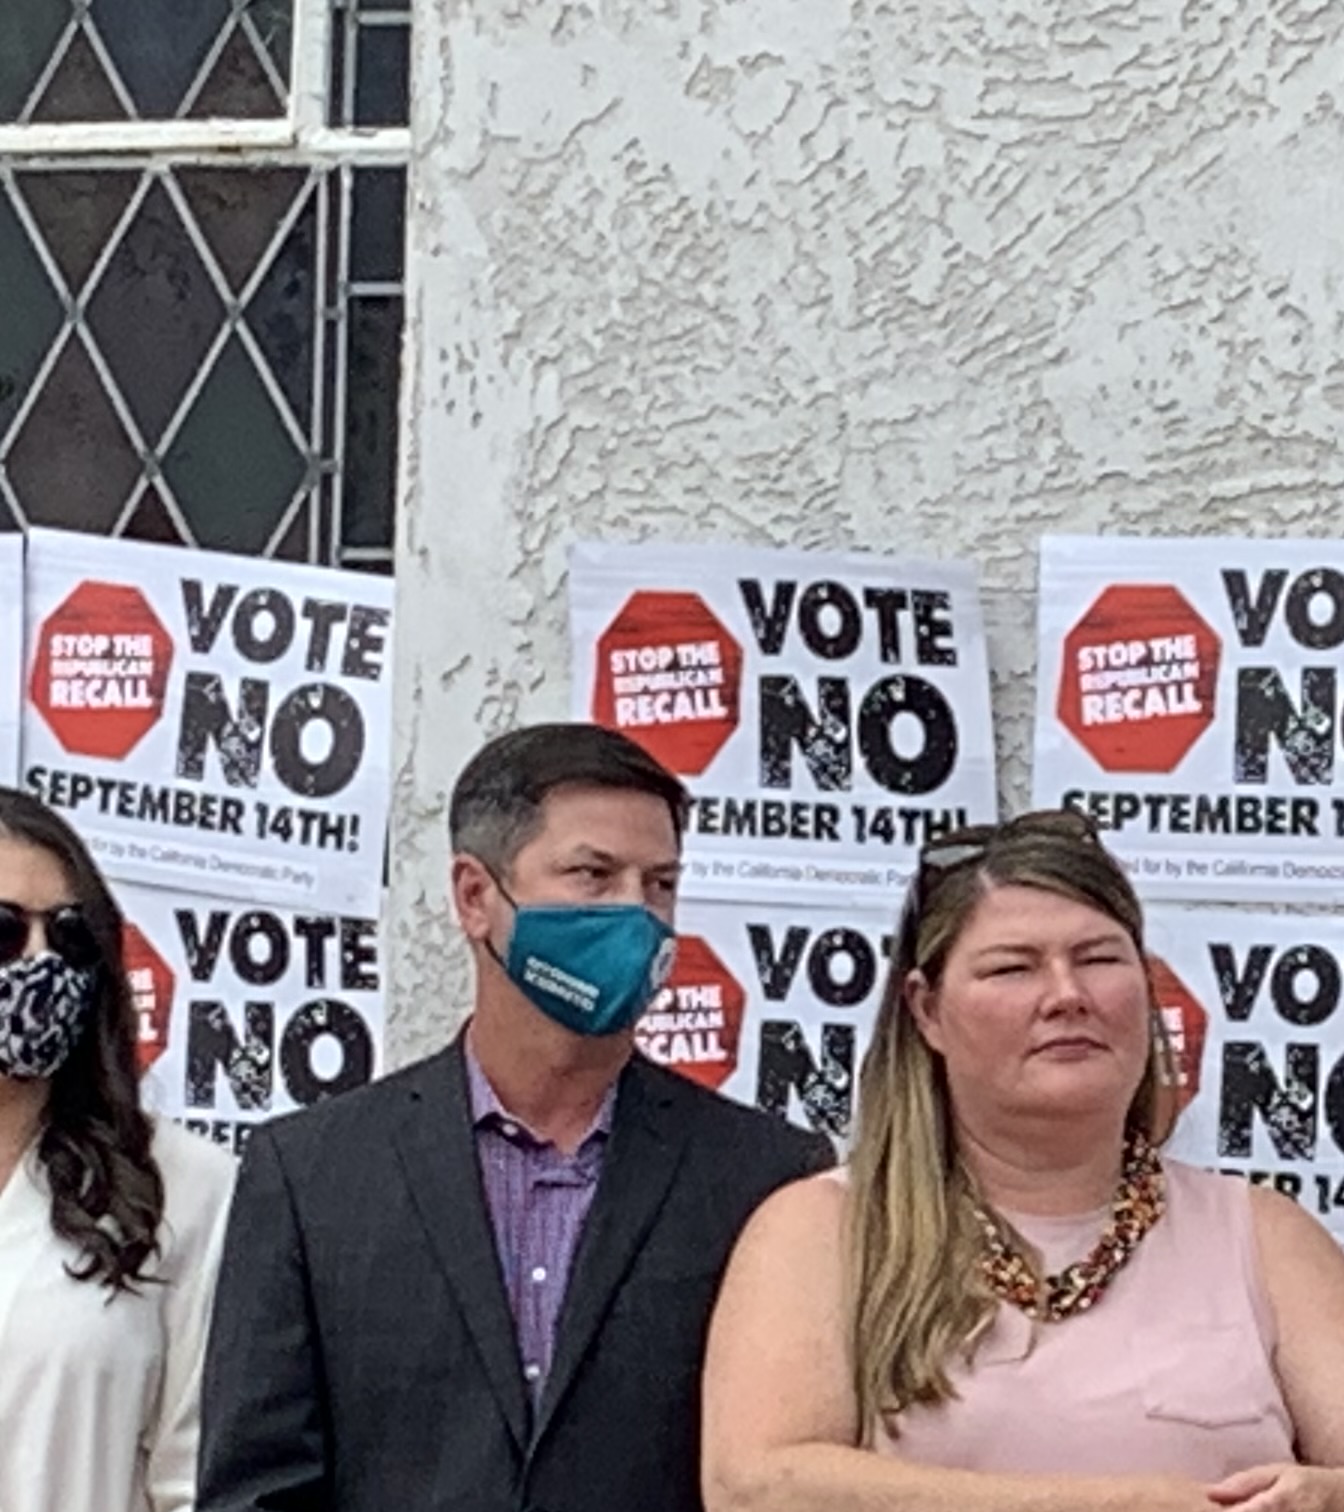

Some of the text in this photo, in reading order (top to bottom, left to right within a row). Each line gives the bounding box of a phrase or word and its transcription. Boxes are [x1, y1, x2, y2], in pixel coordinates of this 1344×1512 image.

[181, 578, 391, 681] VOTE
[738, 578, 957, 667] VOTE
[49, 634, 153, 658] STOP THE
[611, 641, 721, 675] STOP THE
[1078, 634, 1197, 673] STOP THE
[49, 678, 154, 708] RECALL
[616, 688, 728, 728] RECALL
[1082, 682, 1202, 726] RECALL
[176, 671, 365, 798] NO
[759, 674, 959, 796] NO
[27, 766, 360, 853] SEPTEMBER 14TH!
[682, 797, 841, 842] TEMBER
[1212, 859, 1278, 878] California
[174, 908, 379, 991] VOTE
[746, 923, 893, 1008] VO
[676, 984, 723, 1009] THE
[634, 1009, 725, 1034] UBLICAN
[185, 998, 374, 1111] NO
[634, 1031, 728, 1065] CALL
[756, 1020, 857, 1139] N
